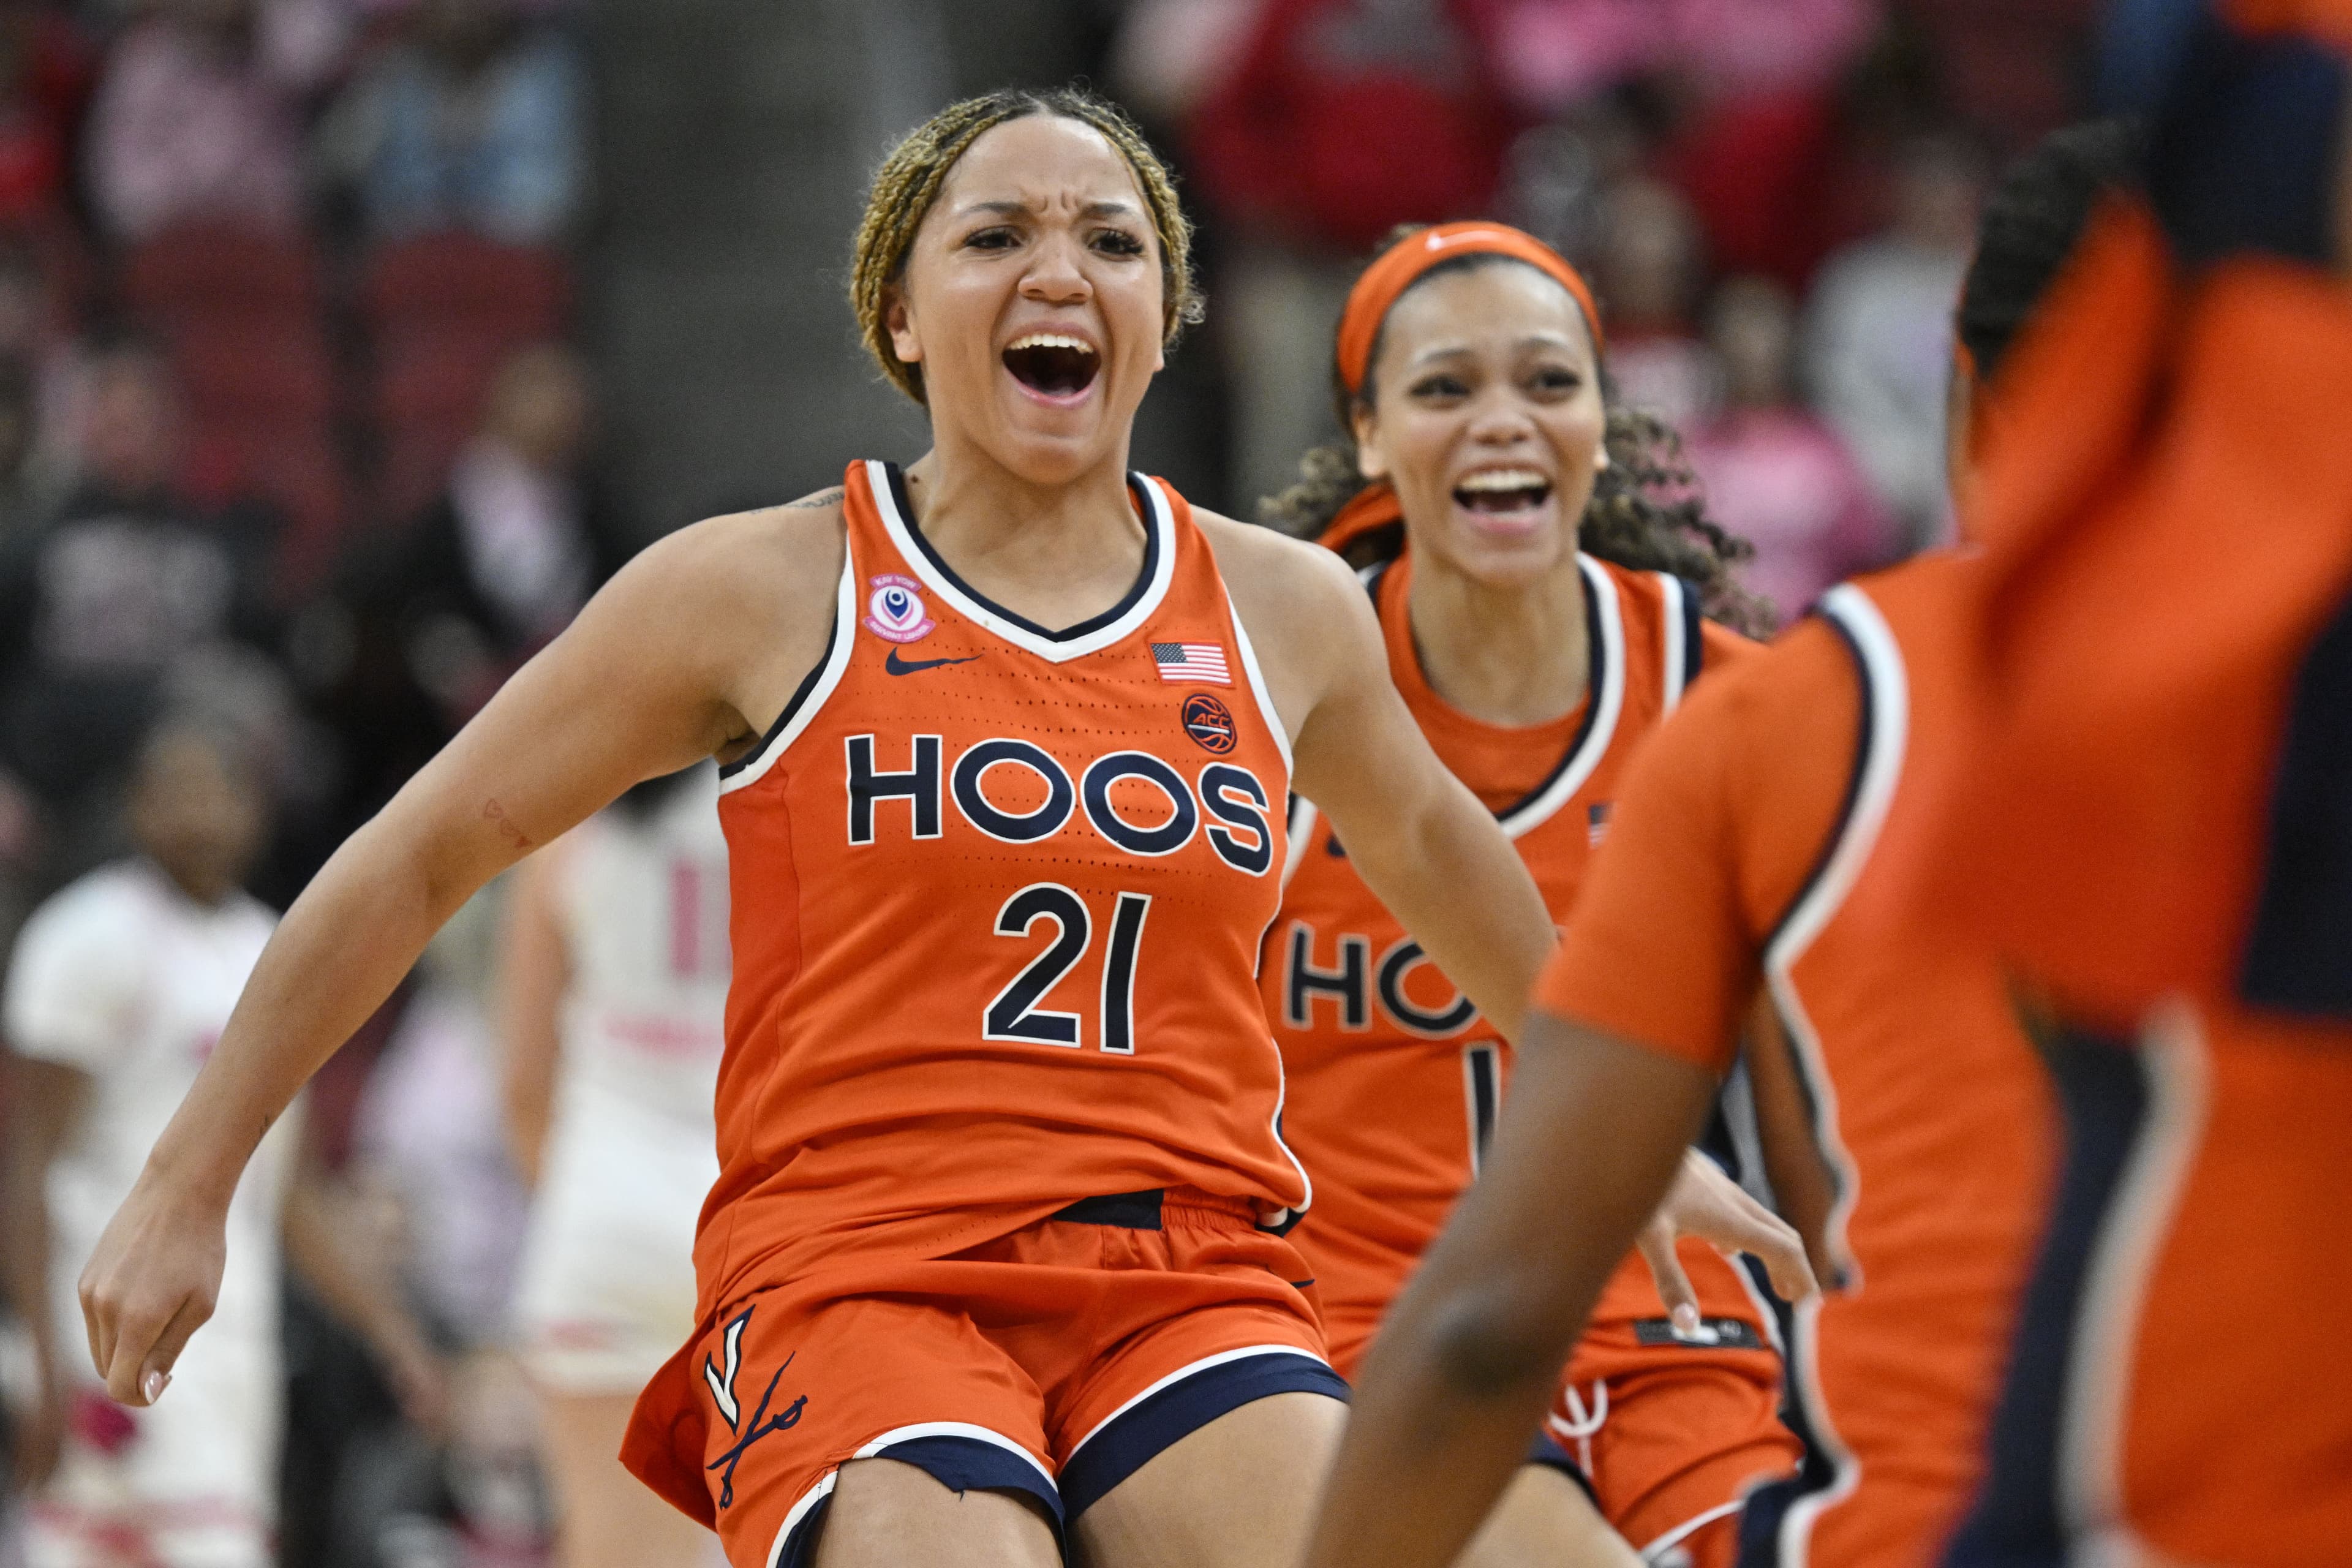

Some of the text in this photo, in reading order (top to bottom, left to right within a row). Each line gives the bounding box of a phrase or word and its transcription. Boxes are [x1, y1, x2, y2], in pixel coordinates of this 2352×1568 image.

[1193, 713, 1231, 729] ACC
[845, 733, 1274, 877] HOOS
[982, 881, 1153, 1055] 21
[1282, 918, 1482, 1040] HO
